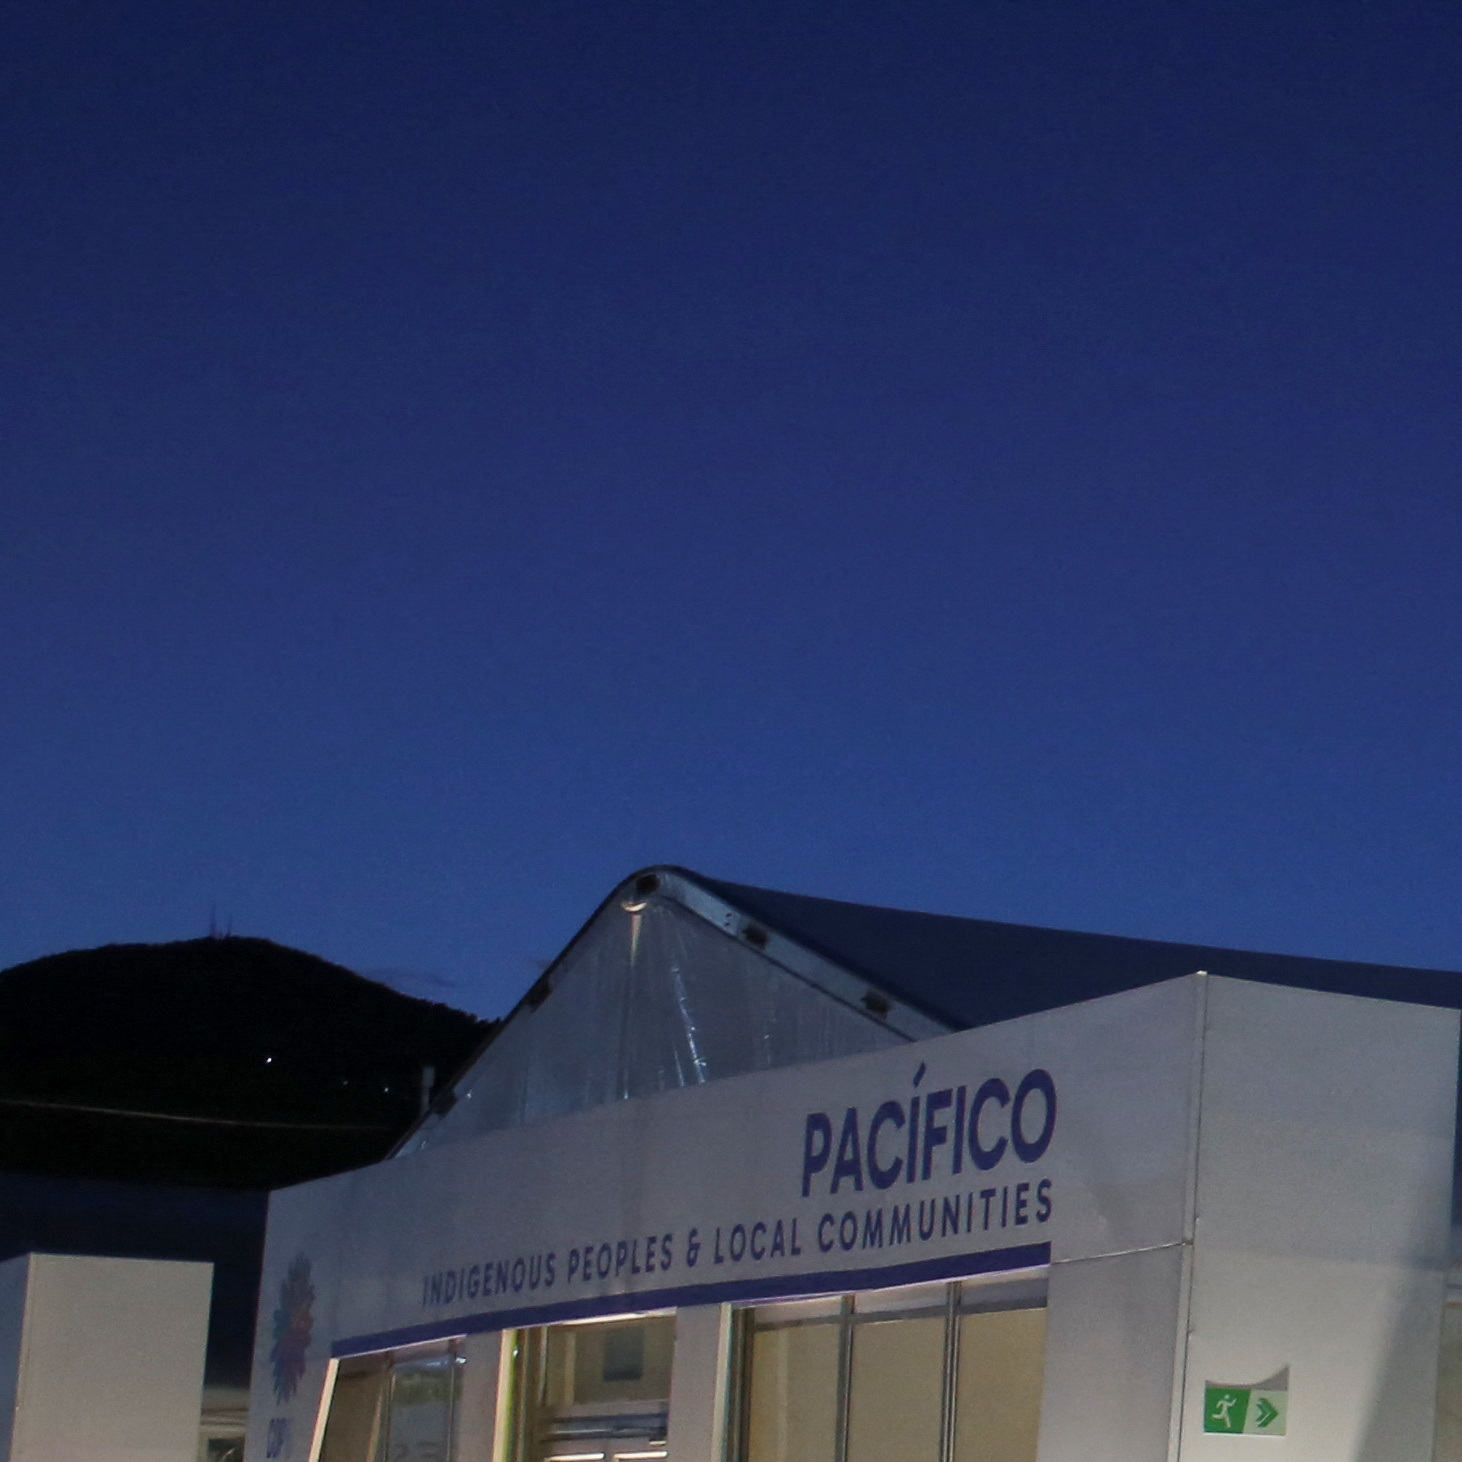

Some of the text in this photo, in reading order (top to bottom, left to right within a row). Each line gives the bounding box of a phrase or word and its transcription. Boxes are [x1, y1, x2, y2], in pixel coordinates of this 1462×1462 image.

[801, 1061, 1057, 1198] PACÍFICO
[422, 1178, 1053, 1308] INDIGENOUS PEOPLES & LOCAL COMMUNITIES
